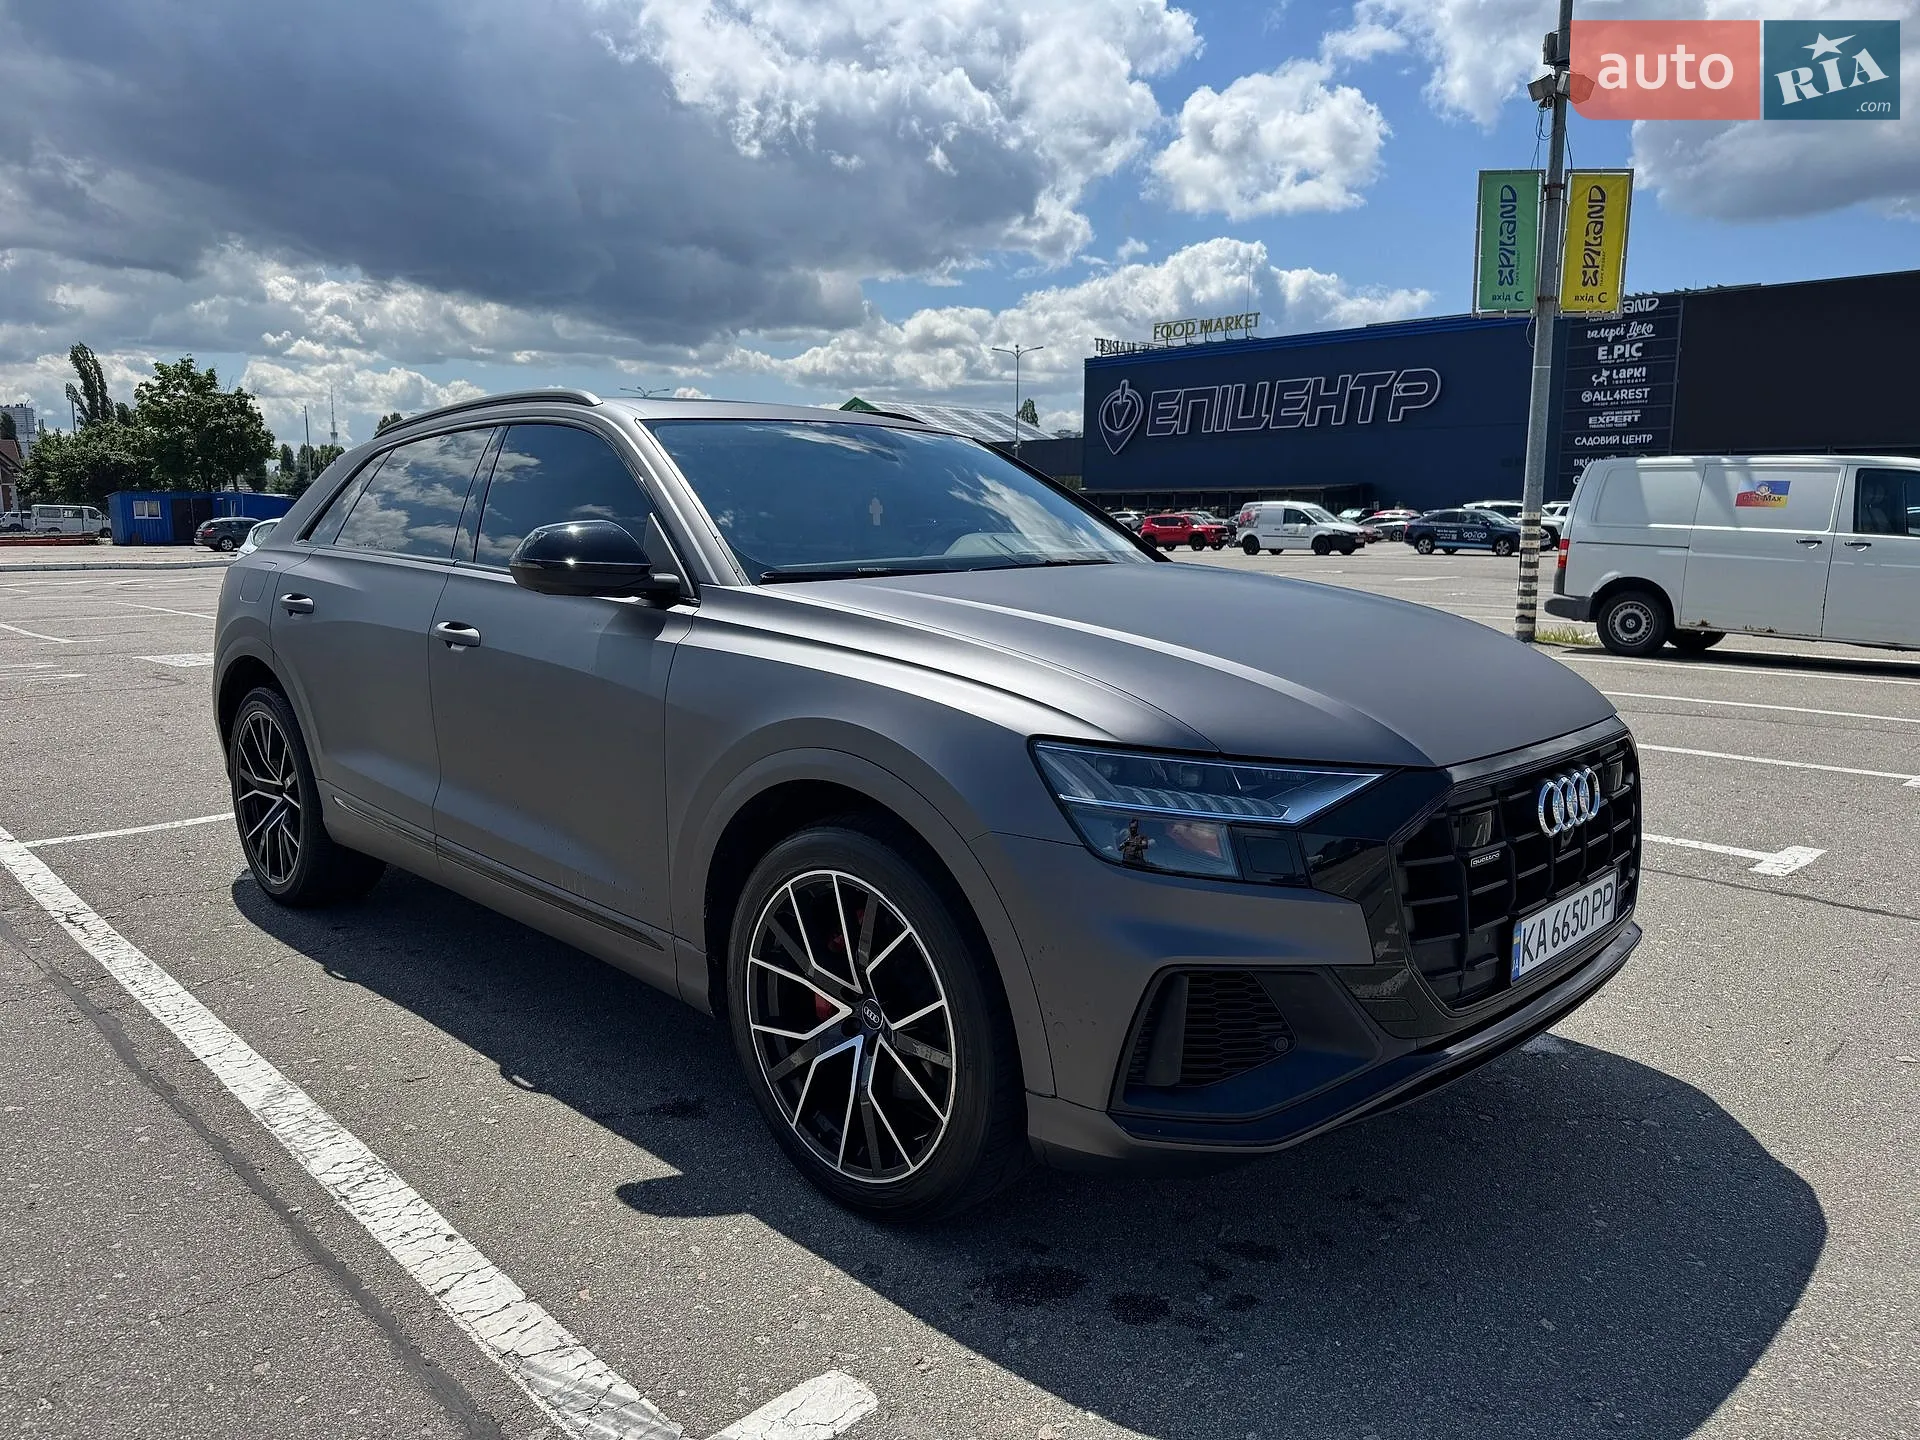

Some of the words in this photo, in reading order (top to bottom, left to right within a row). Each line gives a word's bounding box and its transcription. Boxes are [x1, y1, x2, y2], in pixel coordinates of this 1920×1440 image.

[1492, 292, 1511, 302] вхід
[1574, 293, 1594, 303] вхід
[1153, 321, 1196, 340] FOOD
[1200, 312, 1260, 334] MARKET
[1624, 321, 1655, 341] Деко
[1597, 343, 1643, 360] E.PIC
[1147, 368, 1441, 436] ЕПІЦЕНТР
[1593, 388, 1651, 401] ALL4REST
[1588, 414, 1641, 425] EXPERT
[1575, 435, 1620, 446] САДОВИЙ
[1622, 434, 1653, 445] ЦЕНТР
[1521, 918, 1548, 967] KA
[1551, 895, 1589, 948] 6650
[1591, 882, 1615, 927] PP
